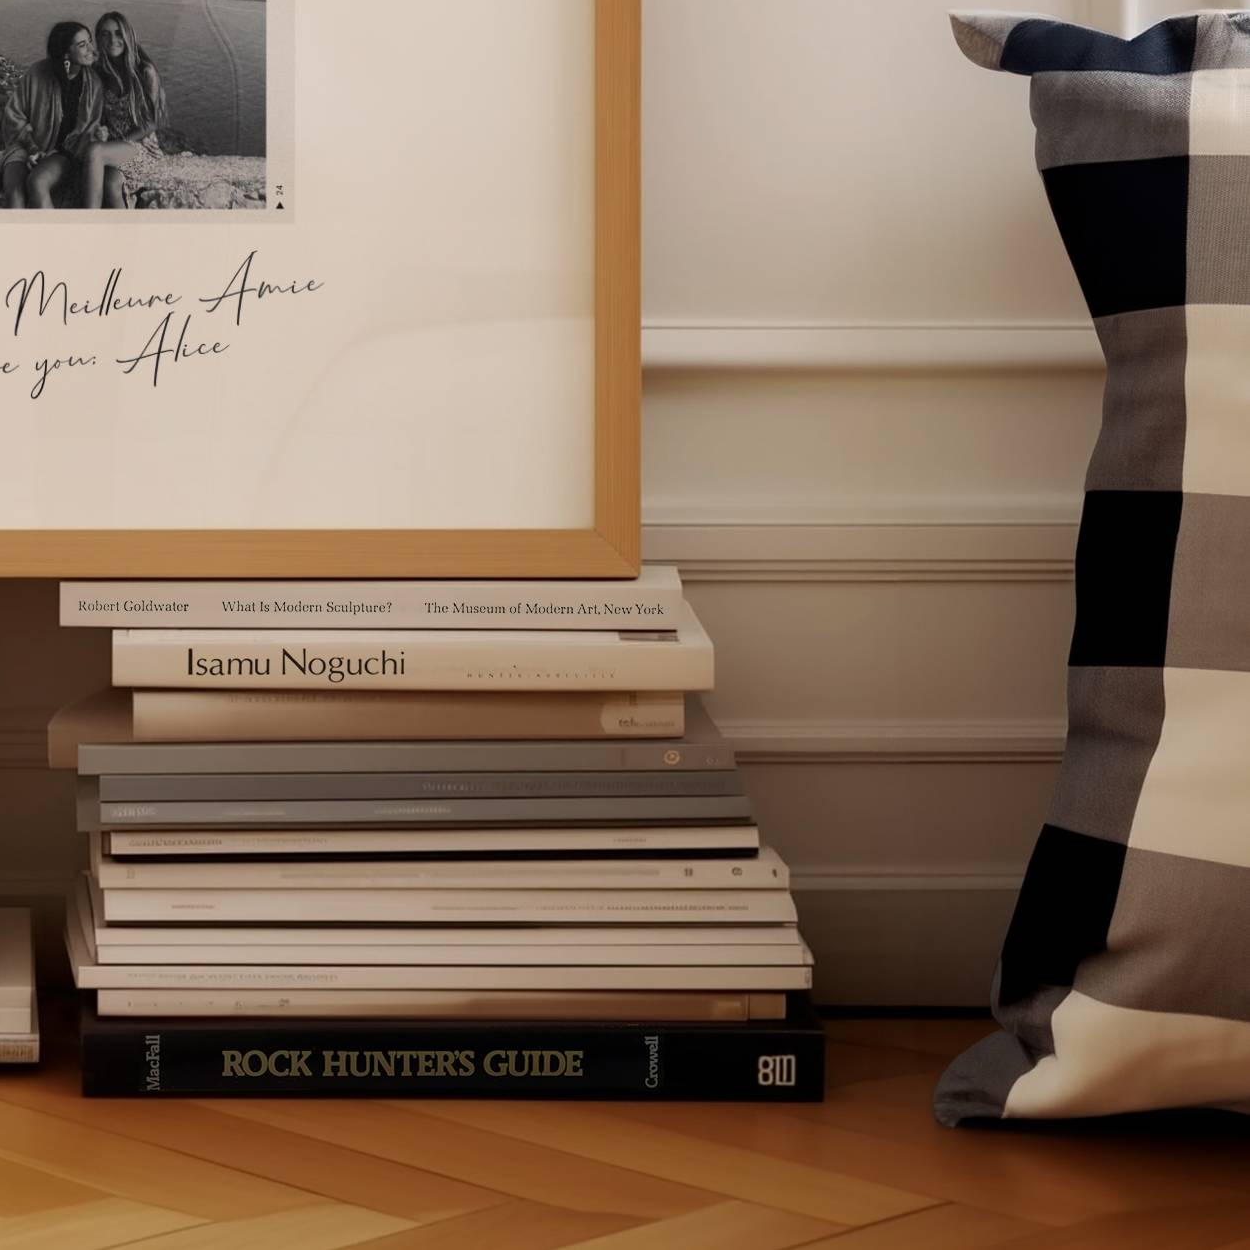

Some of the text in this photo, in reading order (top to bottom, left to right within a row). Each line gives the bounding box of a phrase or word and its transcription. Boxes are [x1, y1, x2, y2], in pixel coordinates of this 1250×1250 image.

[5, 267, 182, 337] Meilleure
[198, 250, 325, 327] Amie
[115, 310, 231, 388] Alice
[78, 599, 190, 612] Robert Goldwater
[222, 600, 393, 616] What Is Modern Sculpture?
[424, 601, 665, 617] The Museum of Modern Art, New York
[187, 648, 405, 683] Isamu Noguchi
[145, 1034, 161, 1091] MacFall
[221, 1049, 584, 1078] ROCK HUNTER'S GUIDE
[644, 1036, 659, 1089] Crowell
